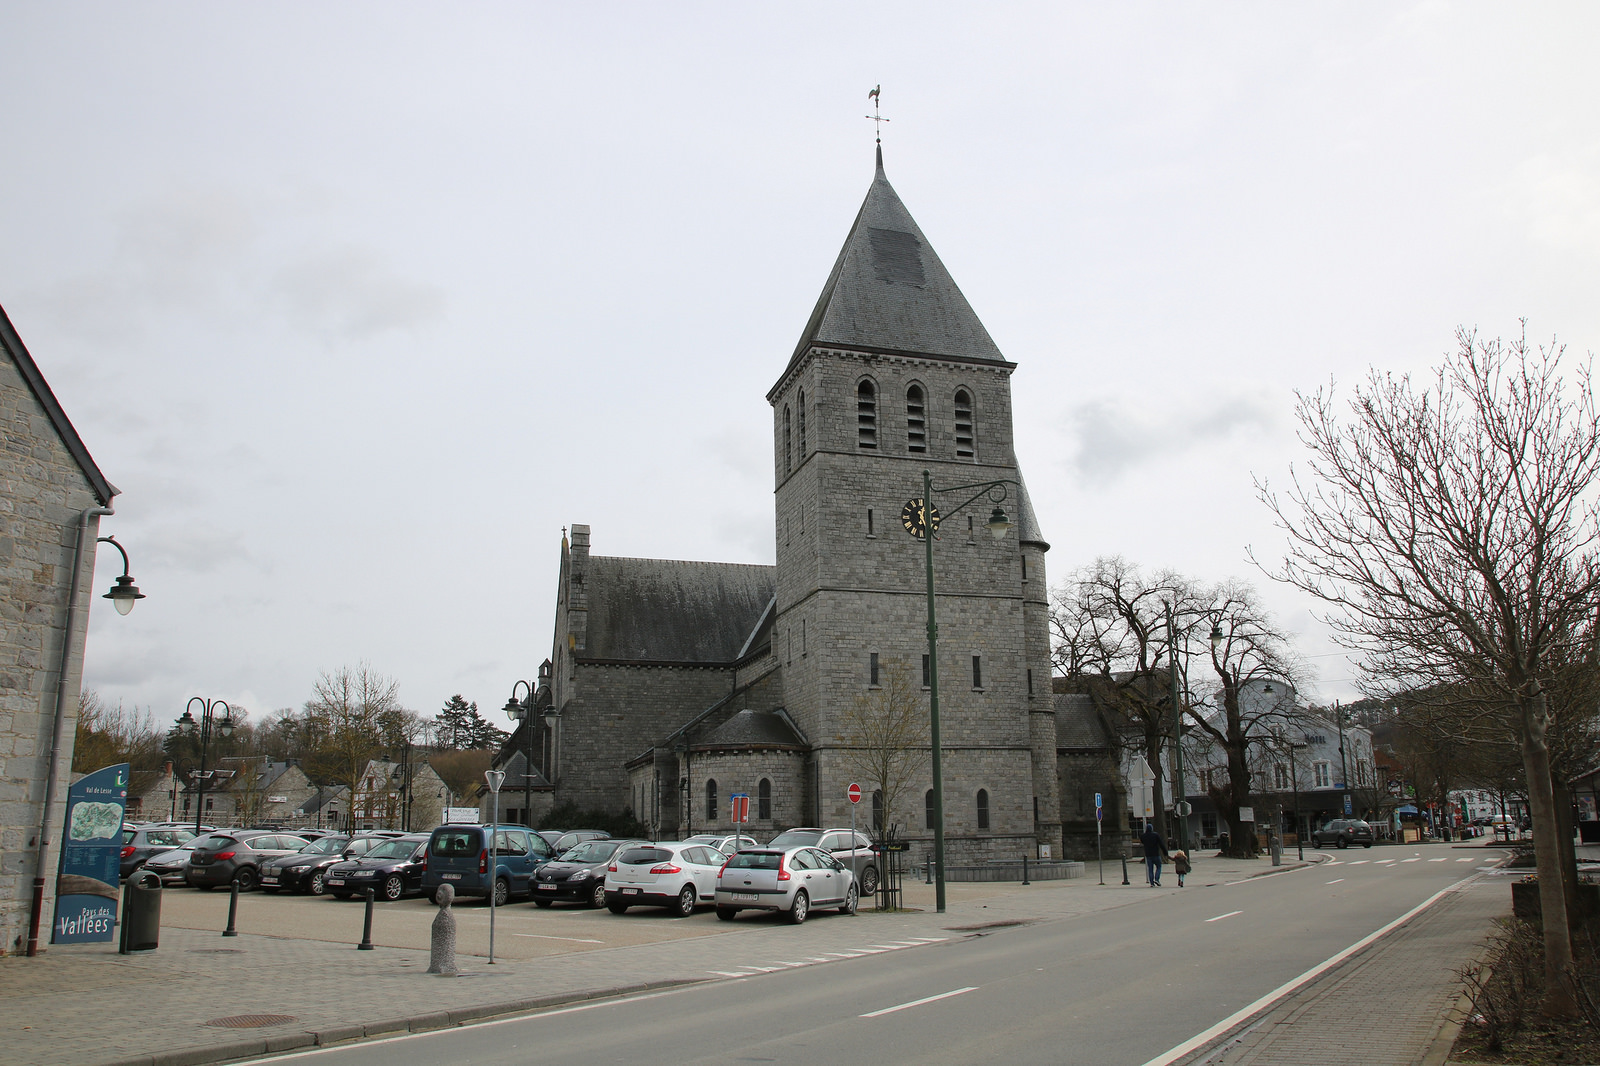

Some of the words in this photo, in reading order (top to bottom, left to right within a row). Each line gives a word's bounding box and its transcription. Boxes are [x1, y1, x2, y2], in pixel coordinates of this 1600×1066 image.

[86, 786, 94, 794] Val
[100, 787, 113, 795] Lesse
[82, 907, 97, 919] Pays
[98, 906, 110, 916] des
